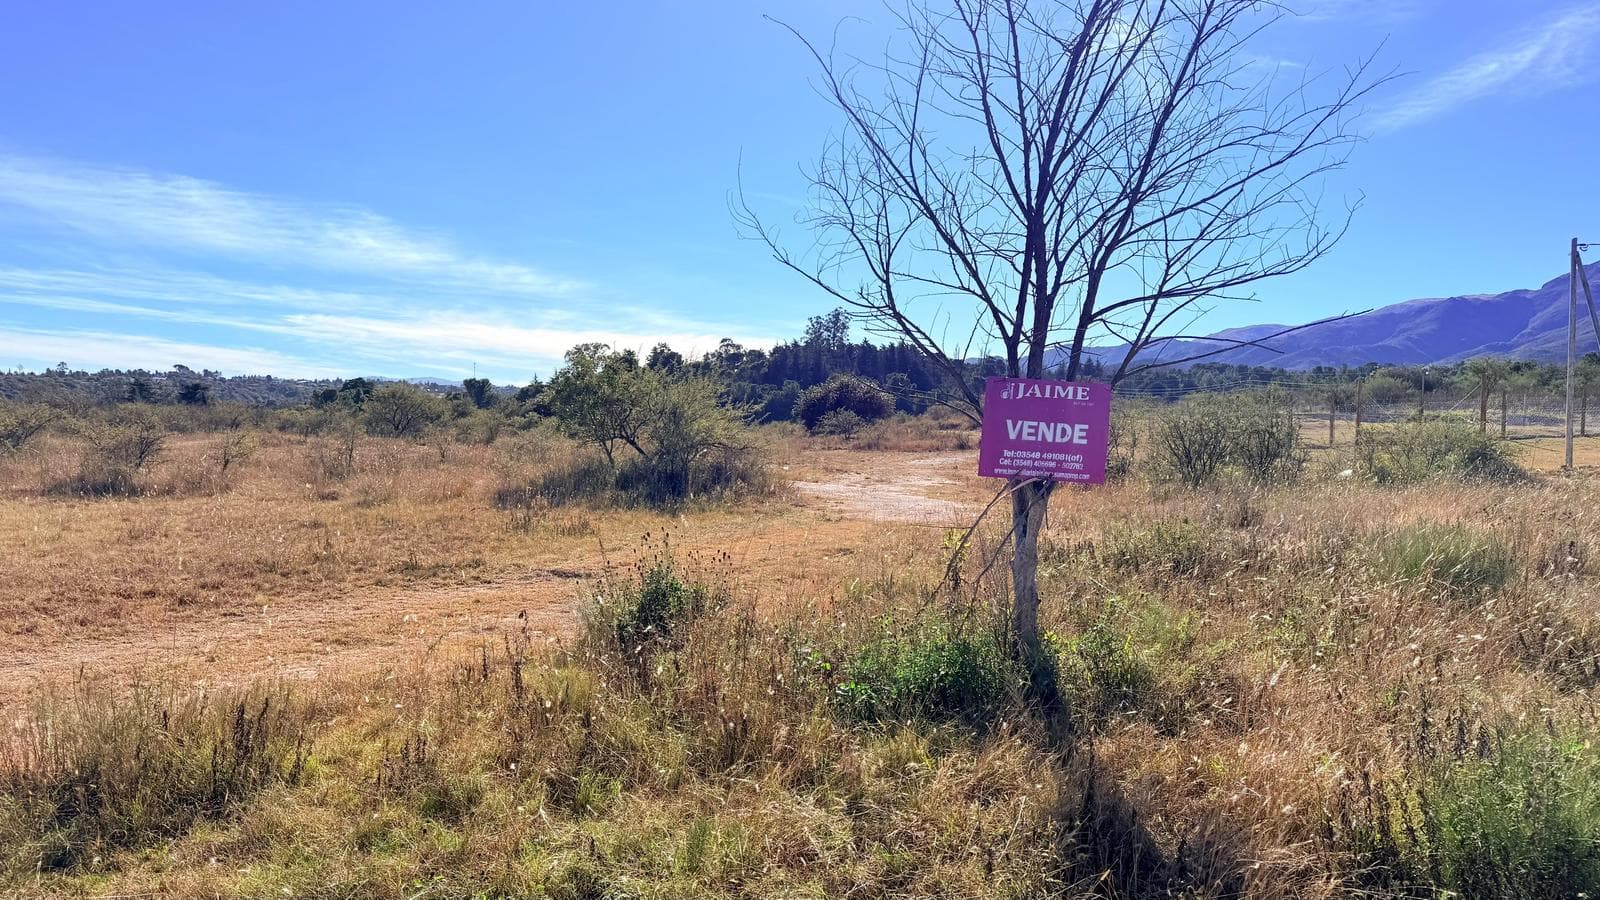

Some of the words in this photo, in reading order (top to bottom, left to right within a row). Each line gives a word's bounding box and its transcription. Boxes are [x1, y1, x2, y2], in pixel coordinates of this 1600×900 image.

[1016, 382, 1090, 401] JAIME
[1006, 419, 1089, 445] VENDE
[1003, 449, 1041, 459] Tel:03548
